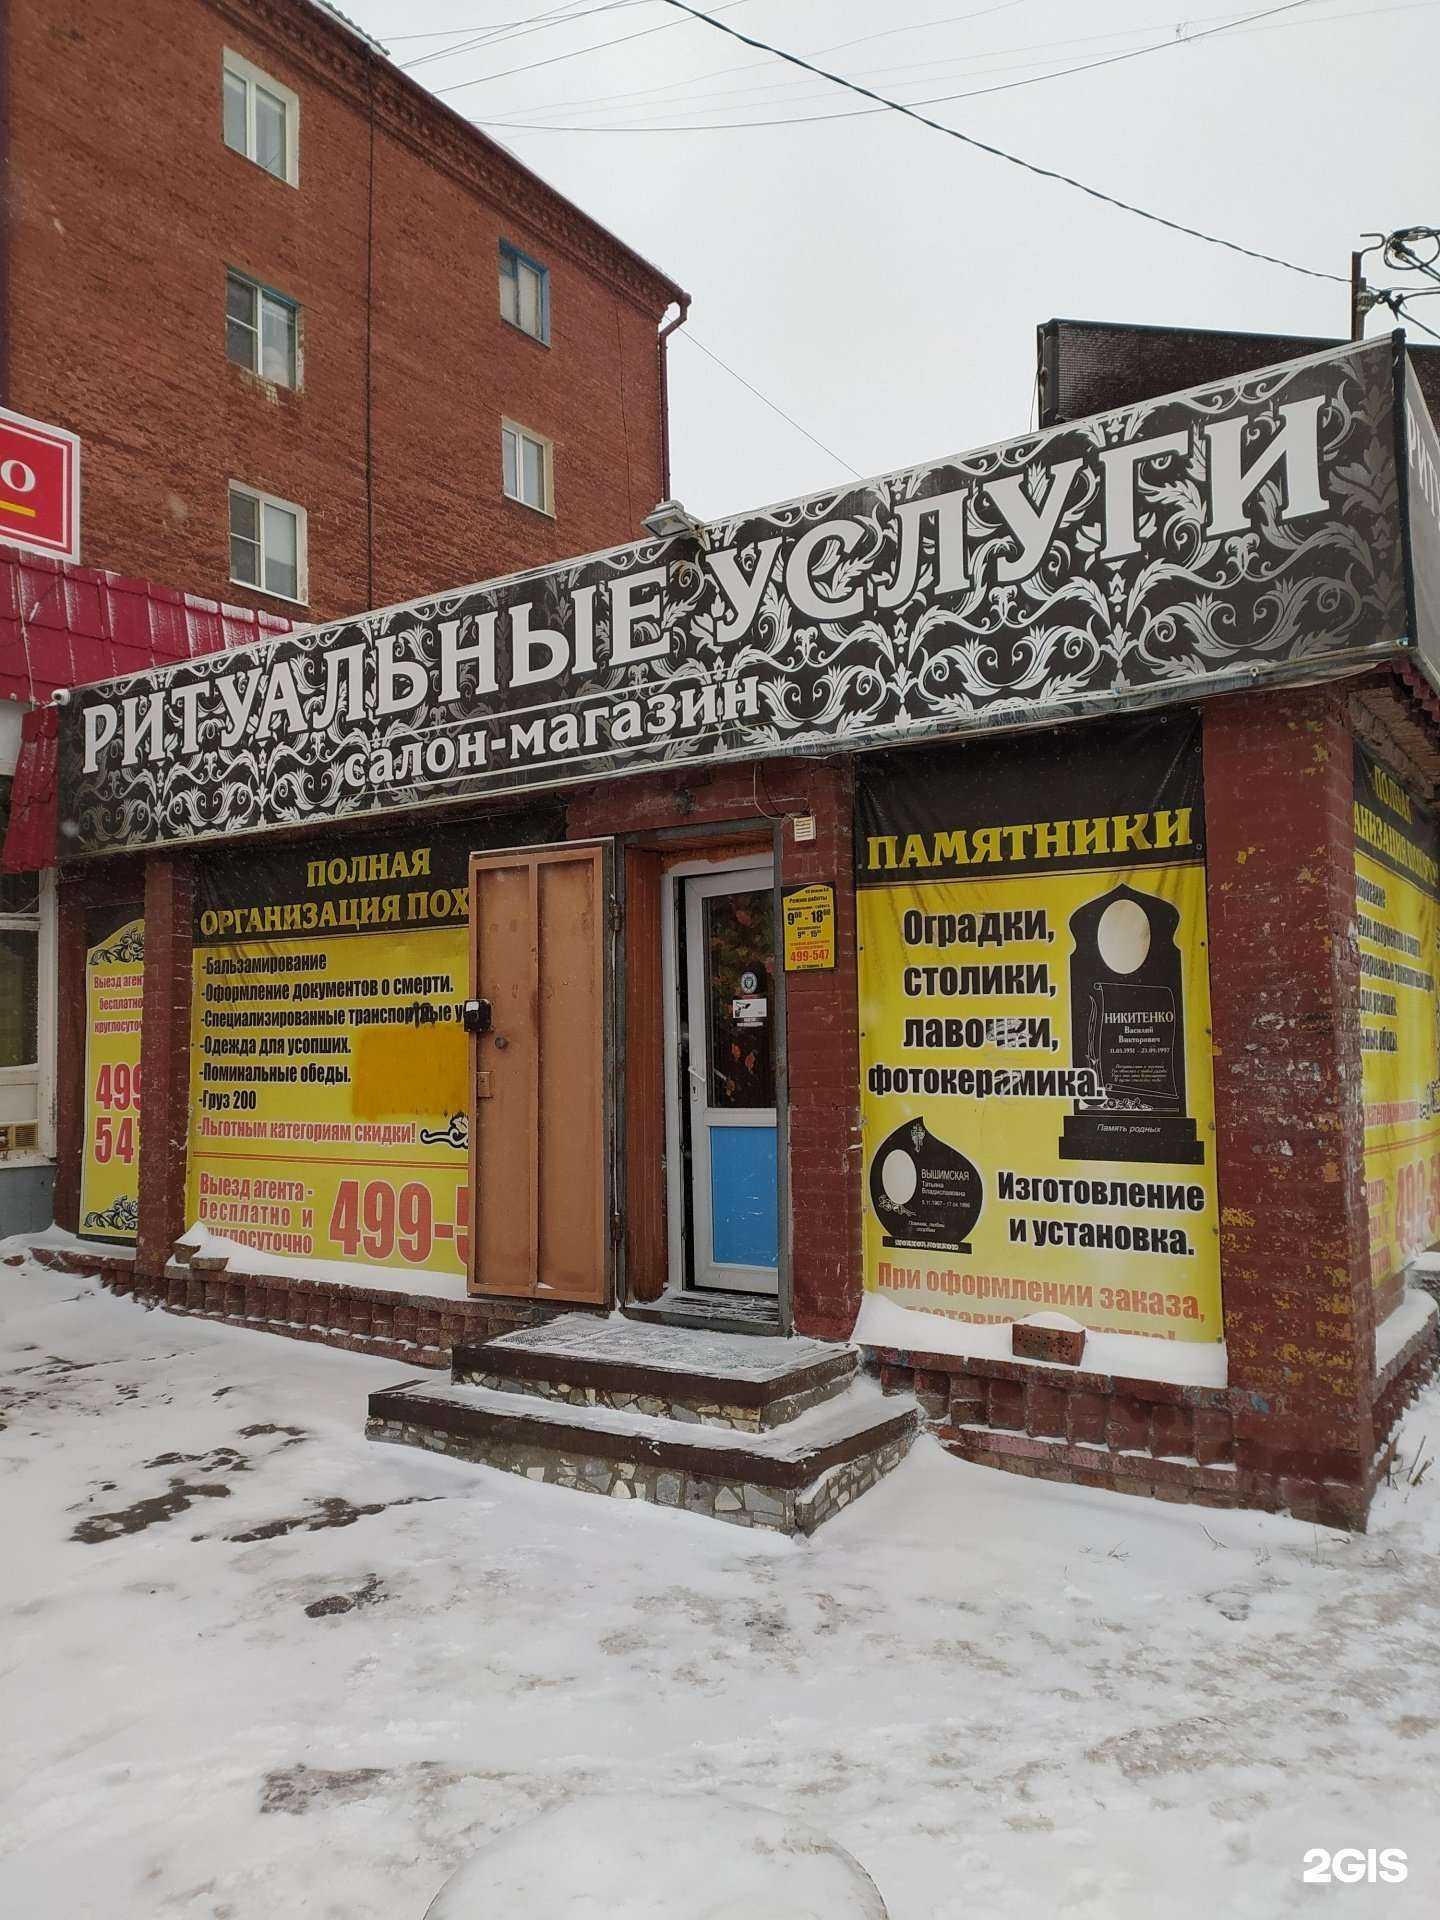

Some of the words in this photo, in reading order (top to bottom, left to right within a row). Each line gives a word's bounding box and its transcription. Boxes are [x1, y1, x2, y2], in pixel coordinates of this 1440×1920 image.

[83, 566, 672, 774] РИТУАЛЬНЫЕ
[706, 396, 1331, 644] УСЛУГИ
[344, 676, 759, 787] салон-магазин
[867, 807, 1193, 869] ПАМЯТНИКИ
[306, 848, 432, 888] ПОЛНАЯ
[201, 894, 400, 936] ОРГАНИЗАЦИЯ
[903, 909, 1055, 948] Оградки,
[790, 949, 830, 962] 499-547
[94, 976, 121, 989] Выезд
[293, 979, 379, 1002] документов
[381, 979, 390, 996] о
[394, 976, 454, 996] смерти.
[903, 964, 1057, 998] столики,
[1104, 1011, 1174, 1024] НИКИТЕНКО
[259, 1038, 285, 1056] для
[288, 1037, 352, 1056] усопших.
[301, 1063, 352, 1085] обеды.
[868, 1064, 1103, 1098] фотокерамика.
[233, 1091, 257, 1110] 200
[95, 1117, 140, 1163] 54
[270, 1123, 351, 1143] категориям
[354, 1123, 417, 1146] скидки!
[1097, 1123, 1127, 1132] Память
[200, 1173, 251, 1198] Выезд
[921, 1168, 970, 1181] ВЫШИМСКАЯ
[998, 1171, 1206, 1211] Изготовление
[199, 1199, 291, 1226] бесплатно
[302, 1208, 313, 1228] и
[1009, 1218, 1027, 1242] и
[1032, 1221, 1195, 1255] установка.
[878, 1262, 920, 1290] При
[926, 1270, 1093, 1307] оформлении
[1099, 1287, 1205, 1324] заказа,
